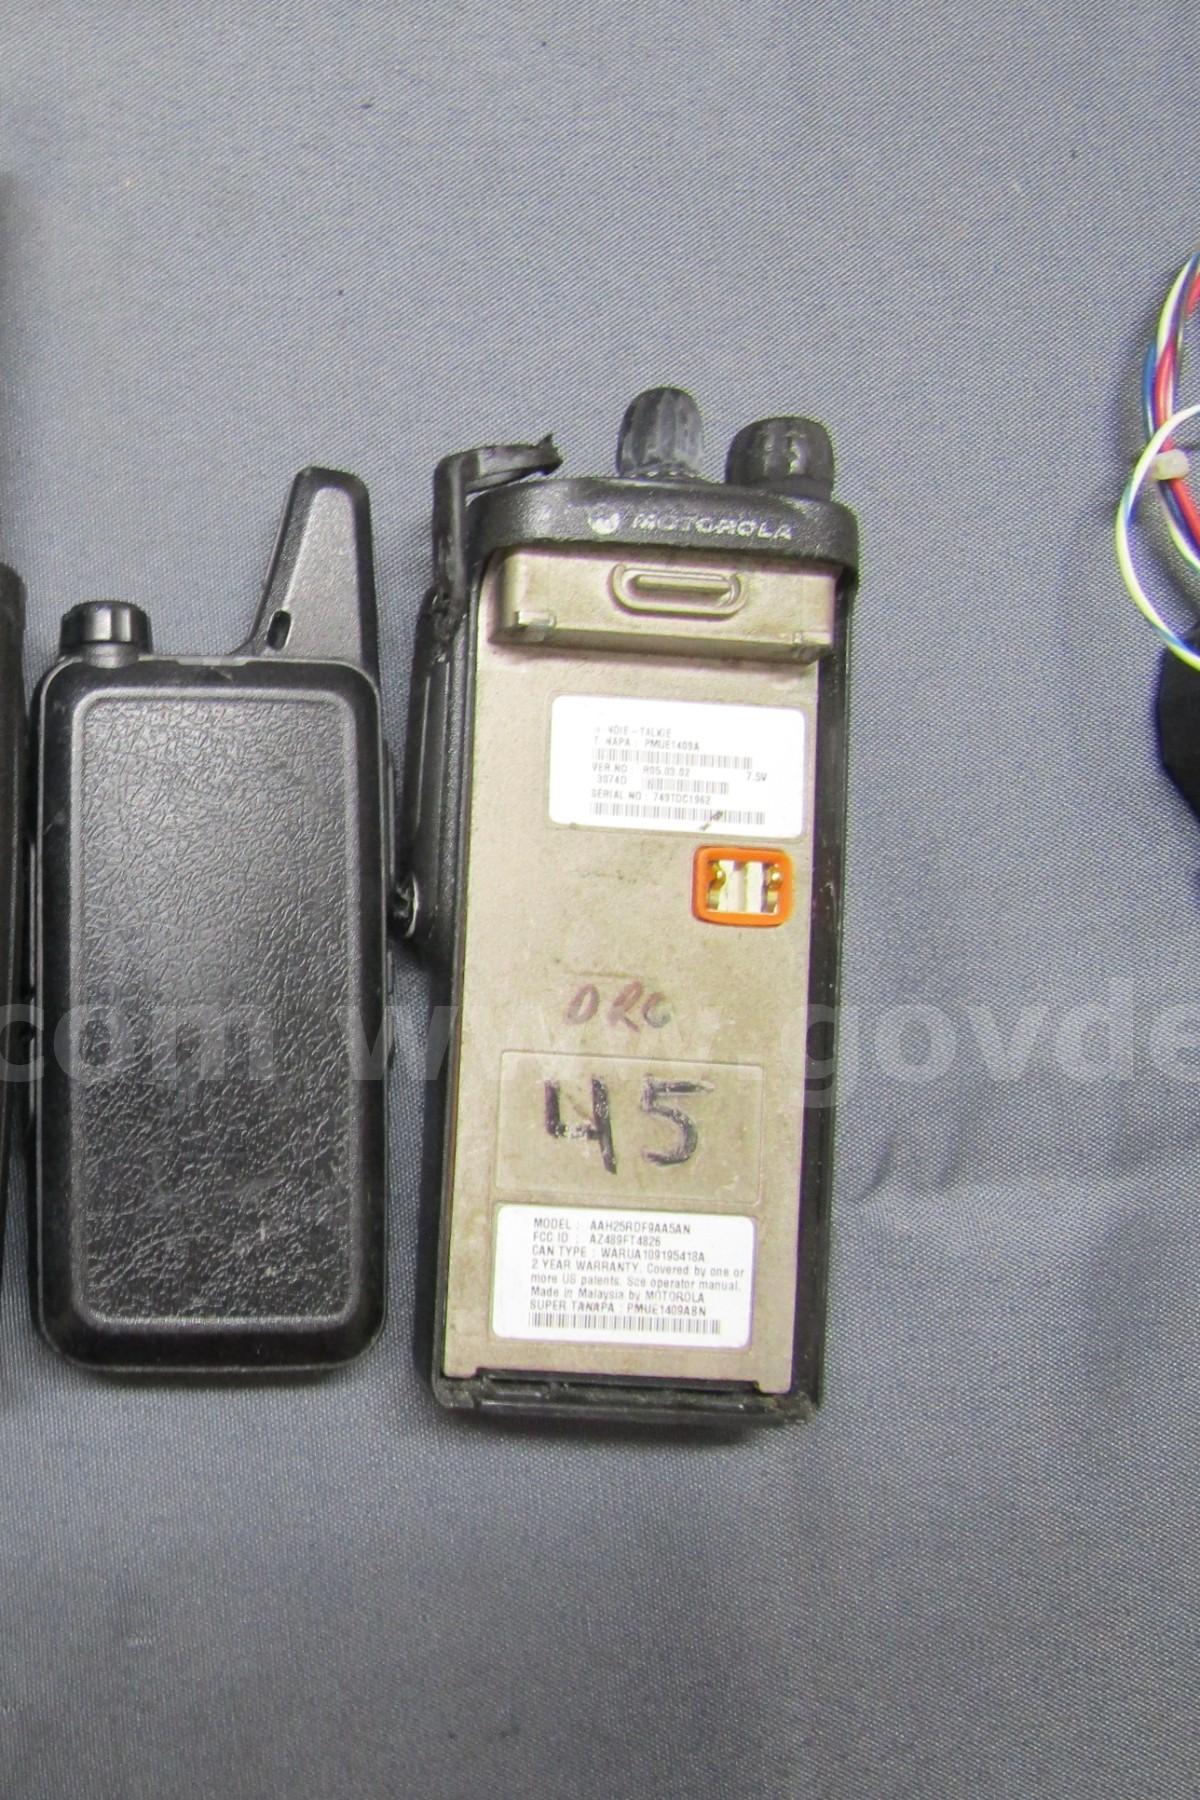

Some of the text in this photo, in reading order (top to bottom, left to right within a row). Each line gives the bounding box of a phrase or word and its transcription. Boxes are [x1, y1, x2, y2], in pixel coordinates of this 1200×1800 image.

[632, 511, 793, 542] MOTOROLA
[543, 1074, 715, 1175] 45
[533, 1218, 572, 1230] MODEL
[533, 1231, 553, 1243] FCC
[557, 1232, 569, 1244] ID
[532, 1244, 554, 1256] CAN
[559, 1245, 587, 1258] TYPE
[531, 1258, 539, 1270] 2
[542, 1258, 571, 1271] YEAR
[646, 1262, 689, 1275] Covered
[694, 1265, 706, 1278] by
[710, 1267, 730, 1277] one
[733, 1268, 745, 1278] or
[530, 1274, 558, 1285] more
[562, 1273, 577, 1285] US
[650, 1278, 695, 1290] operator
[531, 1285, 705, 1304] Made in Malaysia by MOTOROLA
[529, 1299, 567, 1311] SUPER
[571, 1300, 615, 1313] TANAPA
